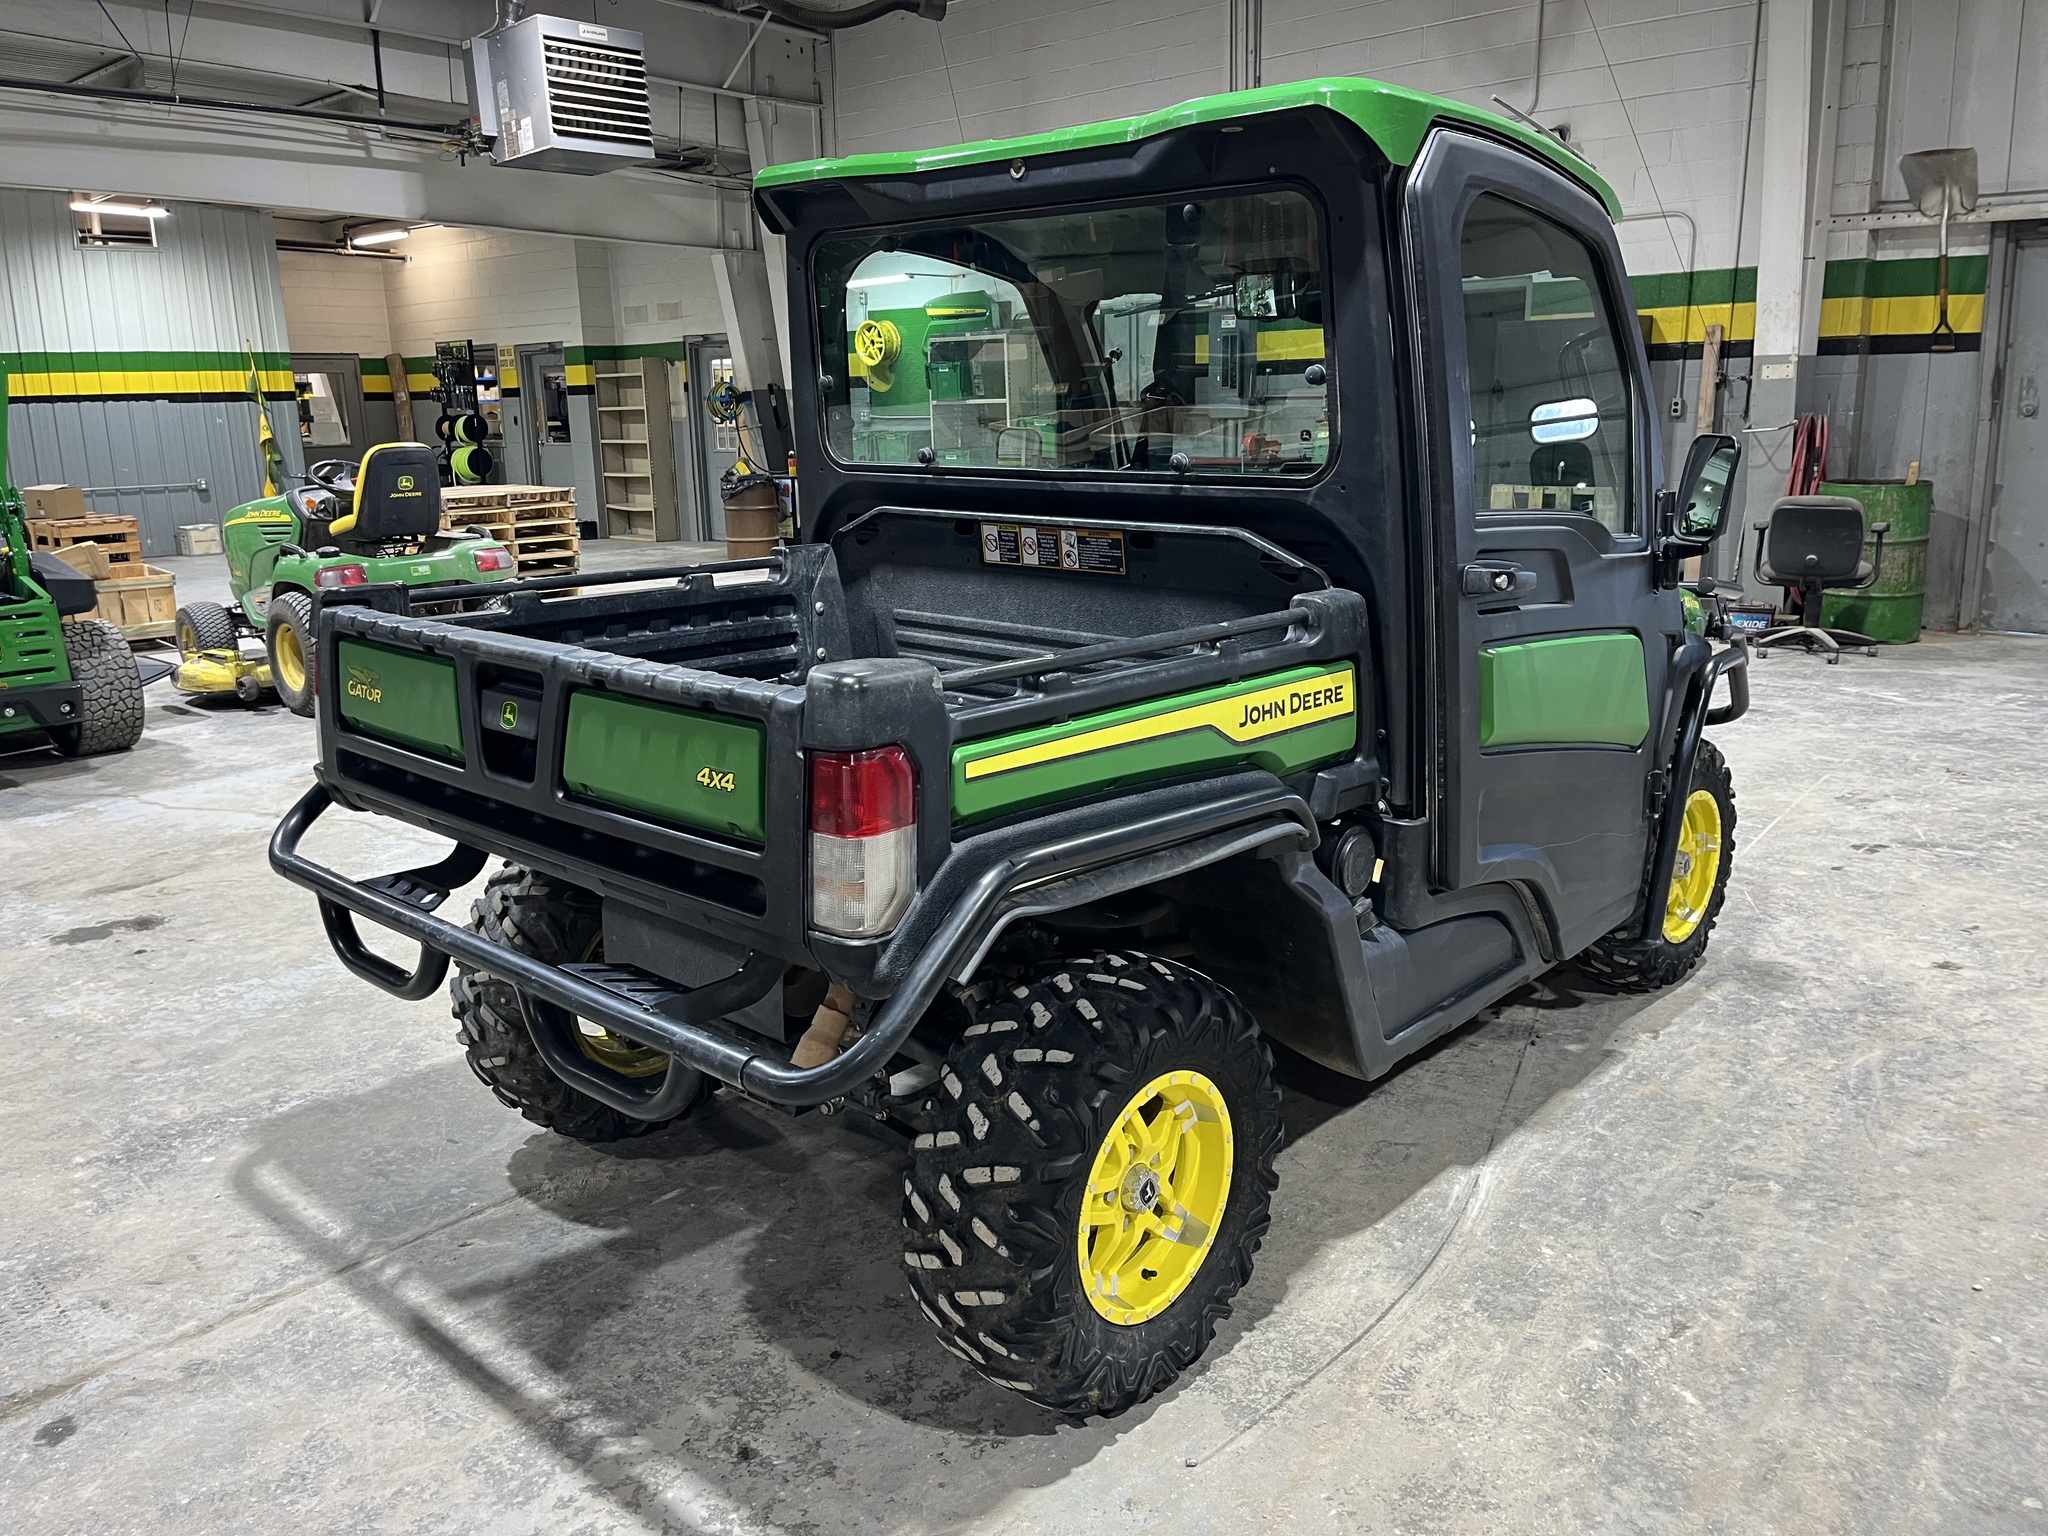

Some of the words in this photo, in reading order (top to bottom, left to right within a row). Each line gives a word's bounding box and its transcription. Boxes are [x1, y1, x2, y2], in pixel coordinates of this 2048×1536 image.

[245, 510, 261, 519] JOHN
[261, 509, 282, 518] DEERE
[1736, 620, 1767, 629] EXIDE
[347, 679, 382, 704] GATOR
[1238, 699, 1286, 729] JOHN
[1289, 684, 1344, 715] DEERE
